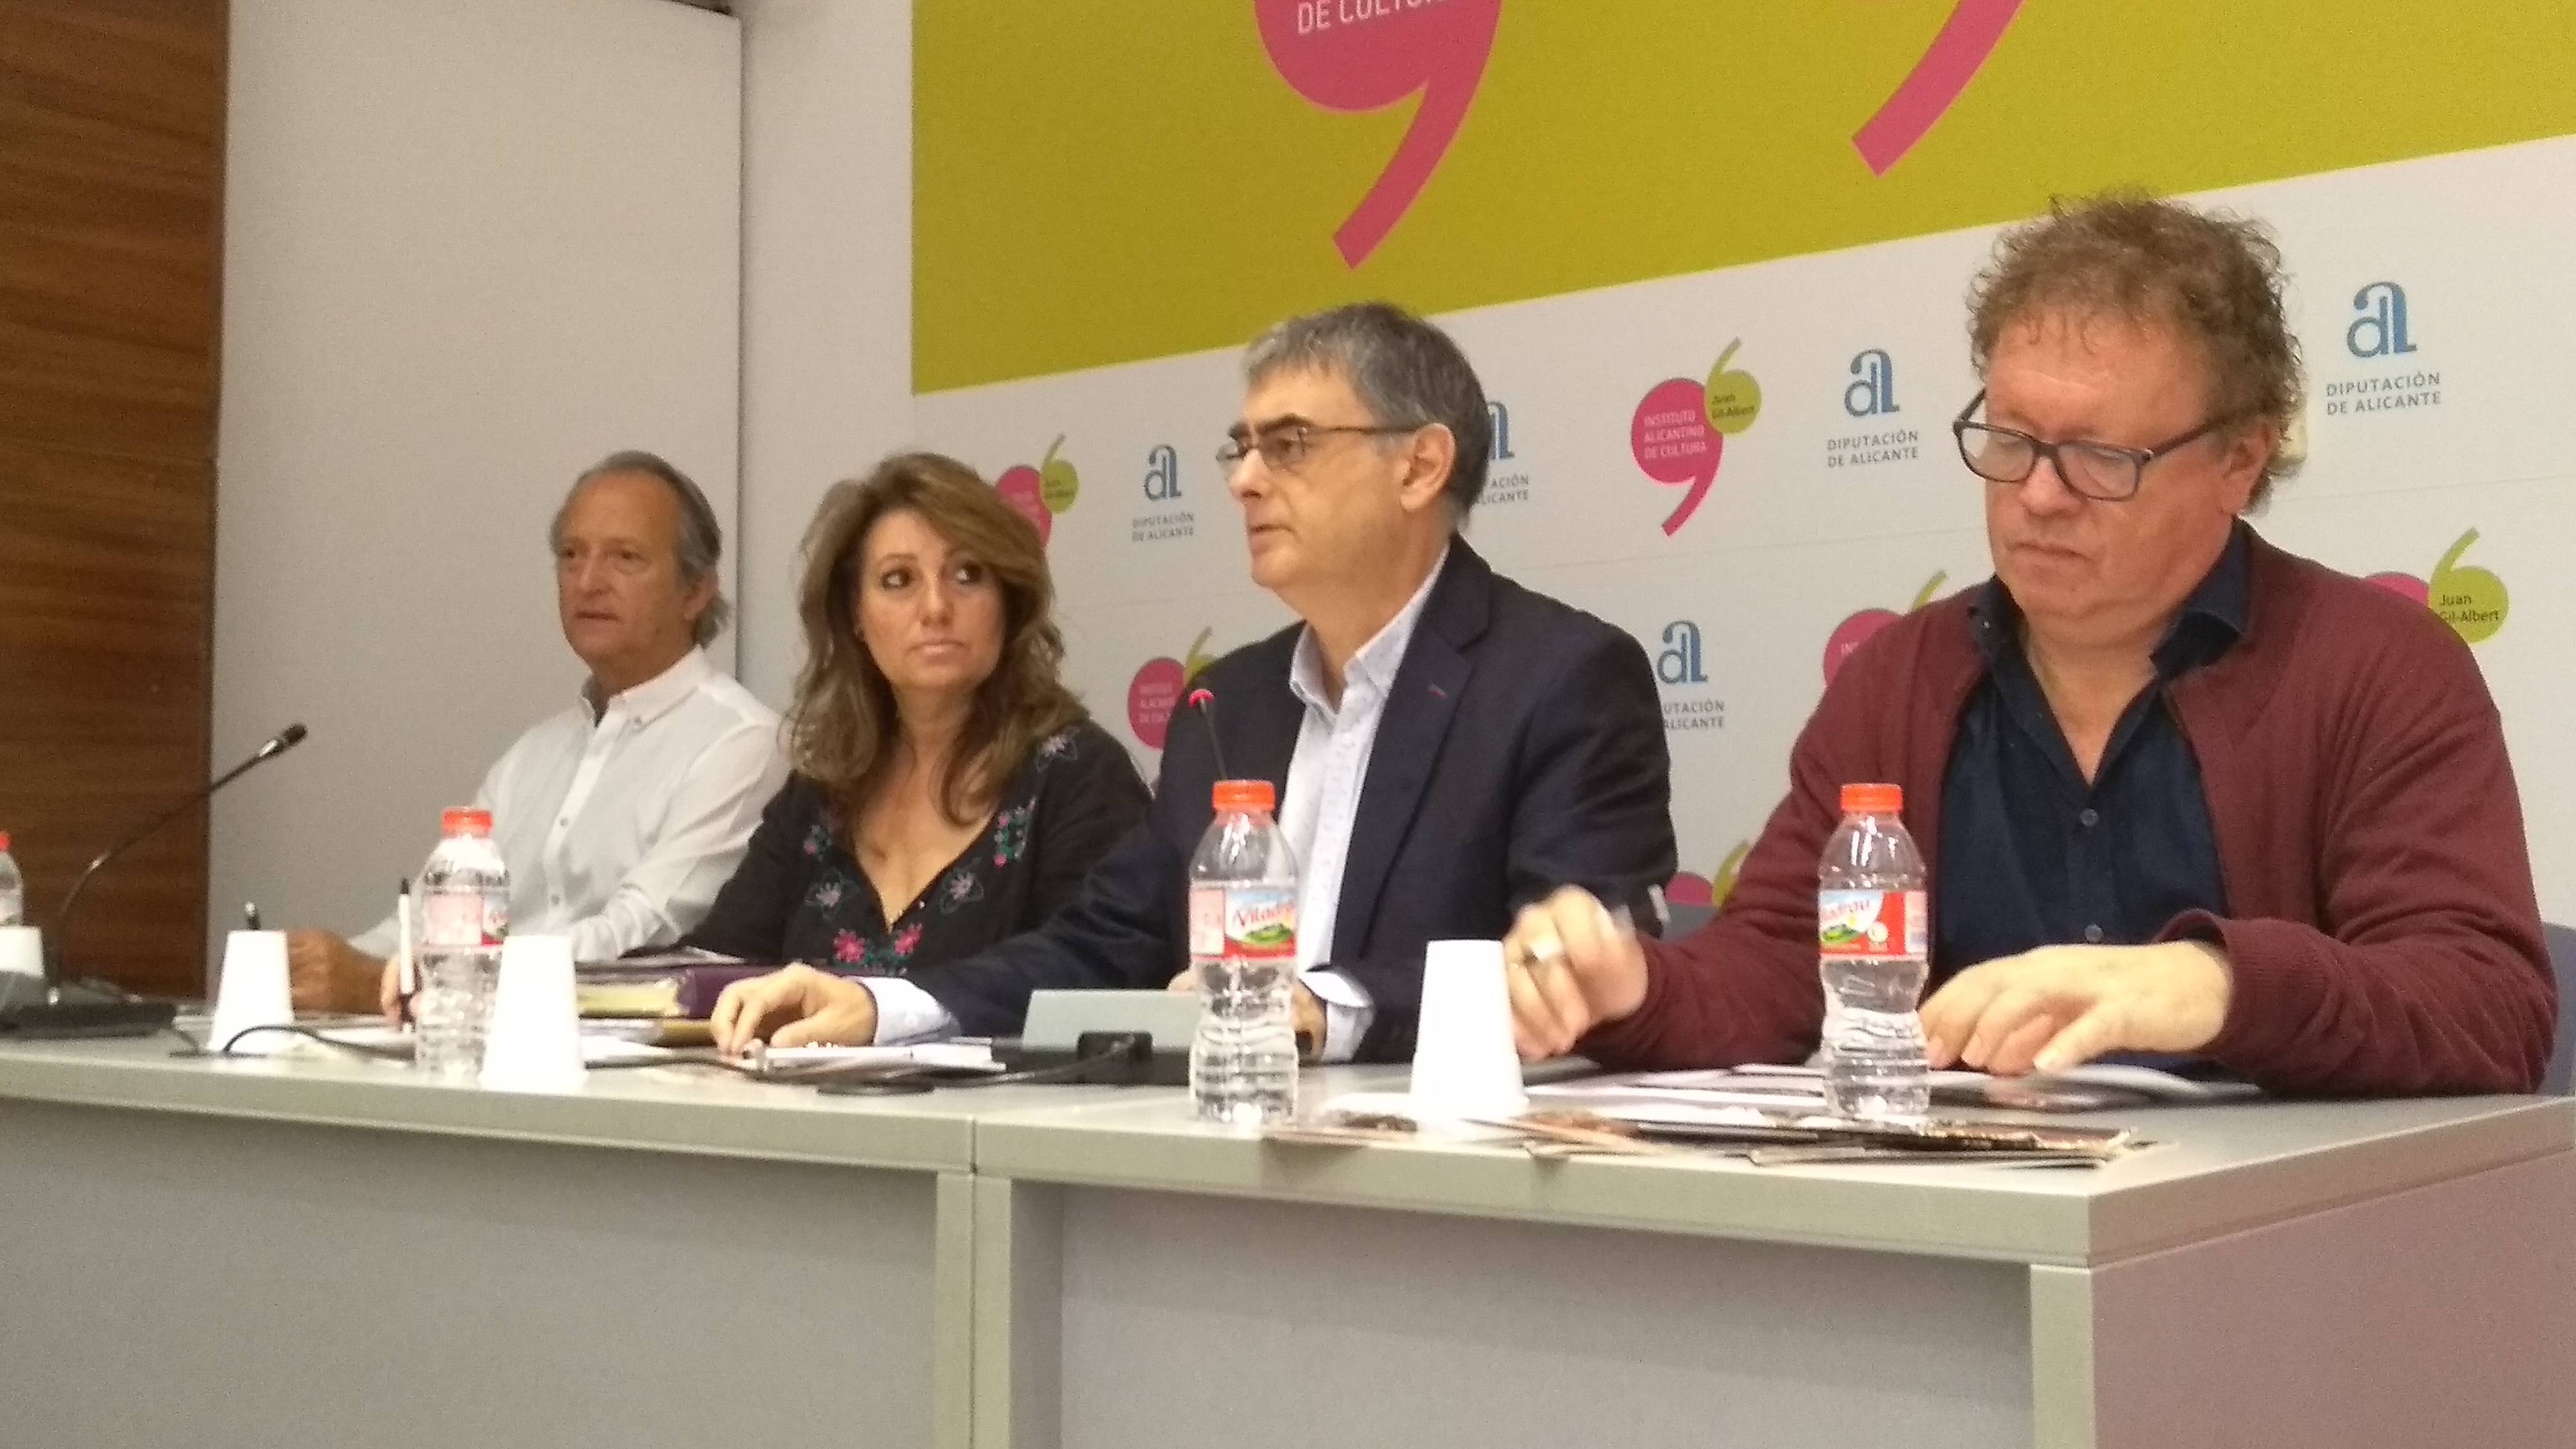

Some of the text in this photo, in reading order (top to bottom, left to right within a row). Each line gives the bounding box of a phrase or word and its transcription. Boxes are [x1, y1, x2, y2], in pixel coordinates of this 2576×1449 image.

[1298, 0, 1331, 34] DE
[2326, 372, 2440, 397] DIPUTACIÓN
[2327, 391, 2441, 415] DE ALICANTE
[1644, 409, 1696, 427] INSTITUTO
[1644, 424, 1705, 442] ALICANTINO
[1827, 430, 1918, 451] DIPUTACIÓN
[1828, 447, 1918, 468] DE ALICANTE
[1491, 473, 1530, 488] ACIÓN
[2439, 594, 2472, 607] Juan
